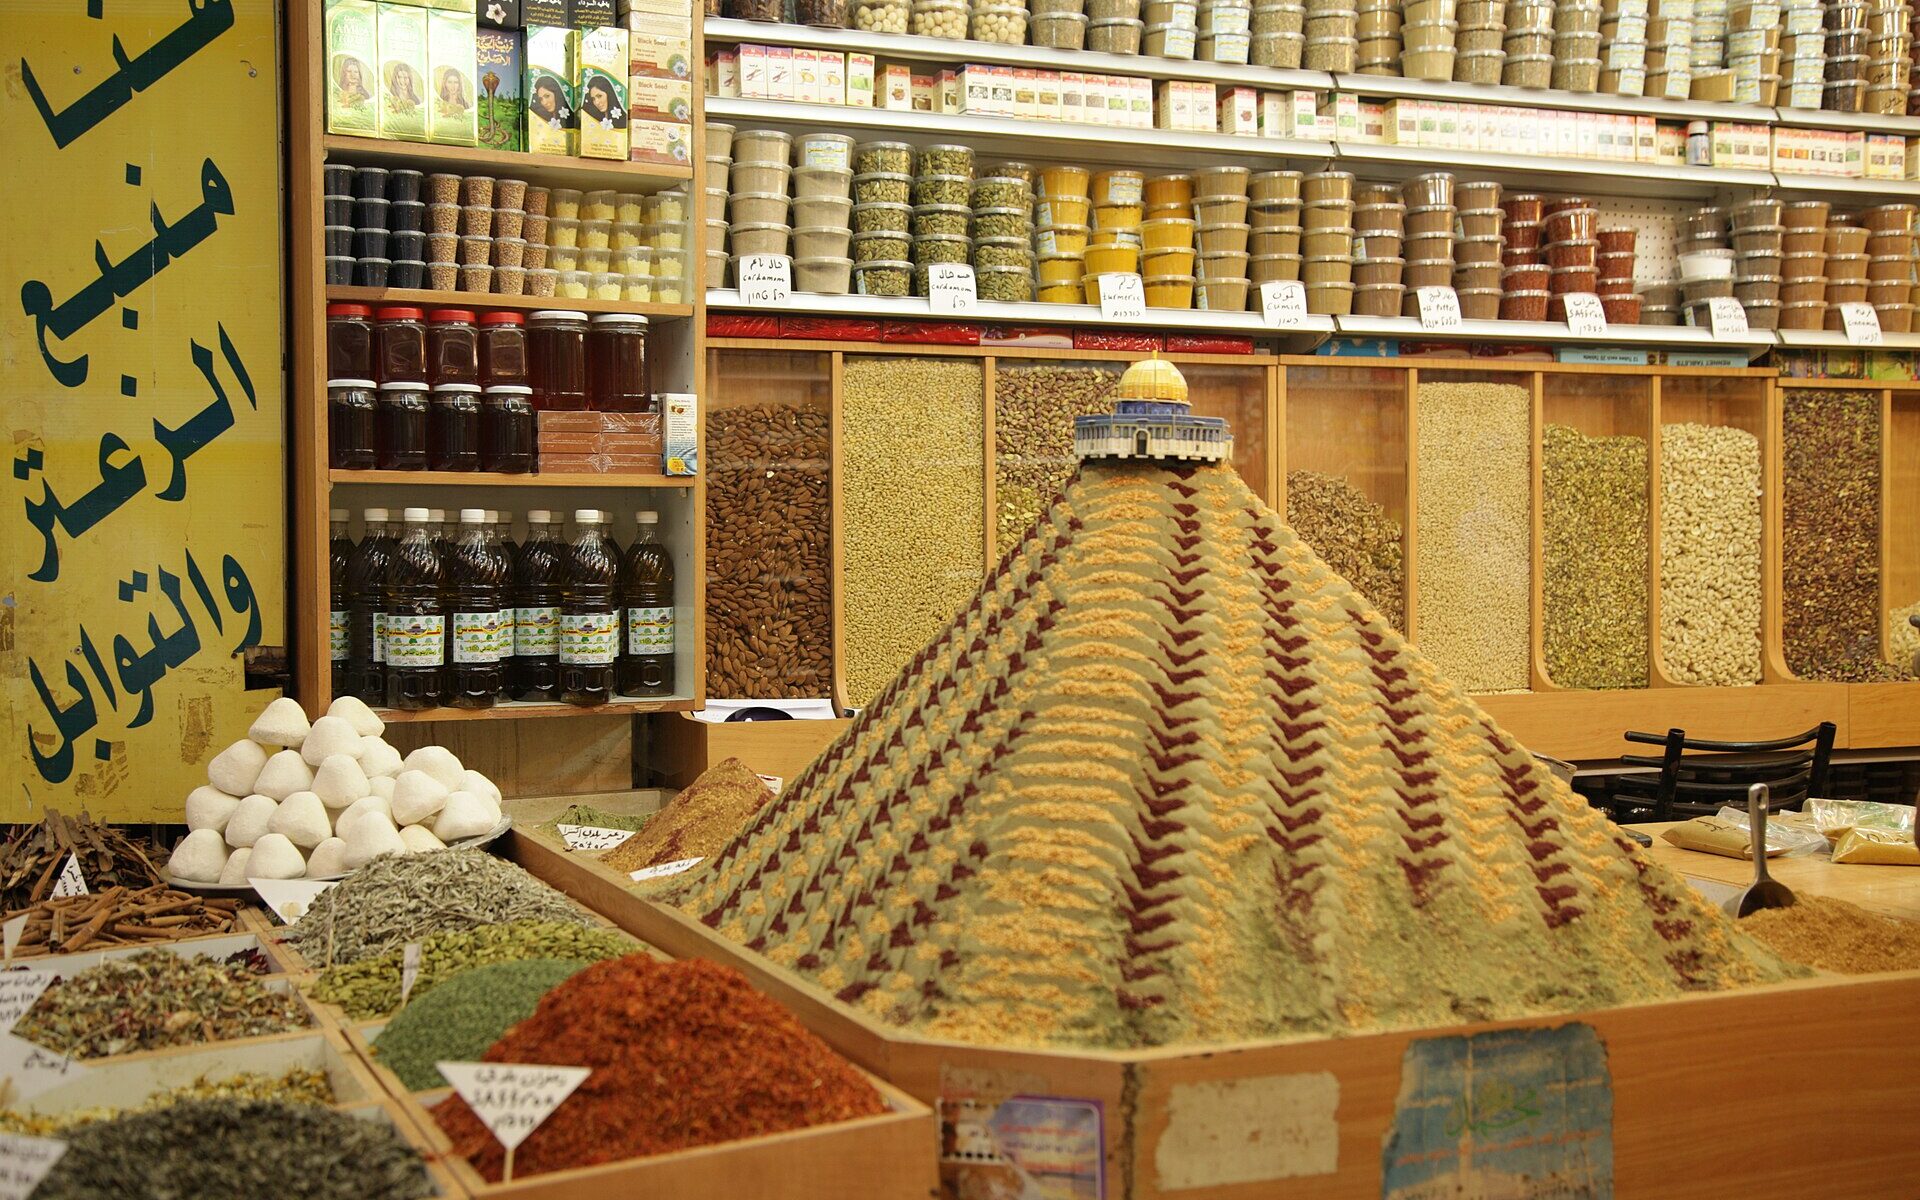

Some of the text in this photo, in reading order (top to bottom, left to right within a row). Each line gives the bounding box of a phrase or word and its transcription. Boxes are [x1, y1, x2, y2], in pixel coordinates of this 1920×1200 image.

[638, 81, 654, 89] Black
[931, 283, 973, 293] cardamom
[1102, 292, 1141, 301] turmeric
[27, 547, 264, 784] والتوابل
